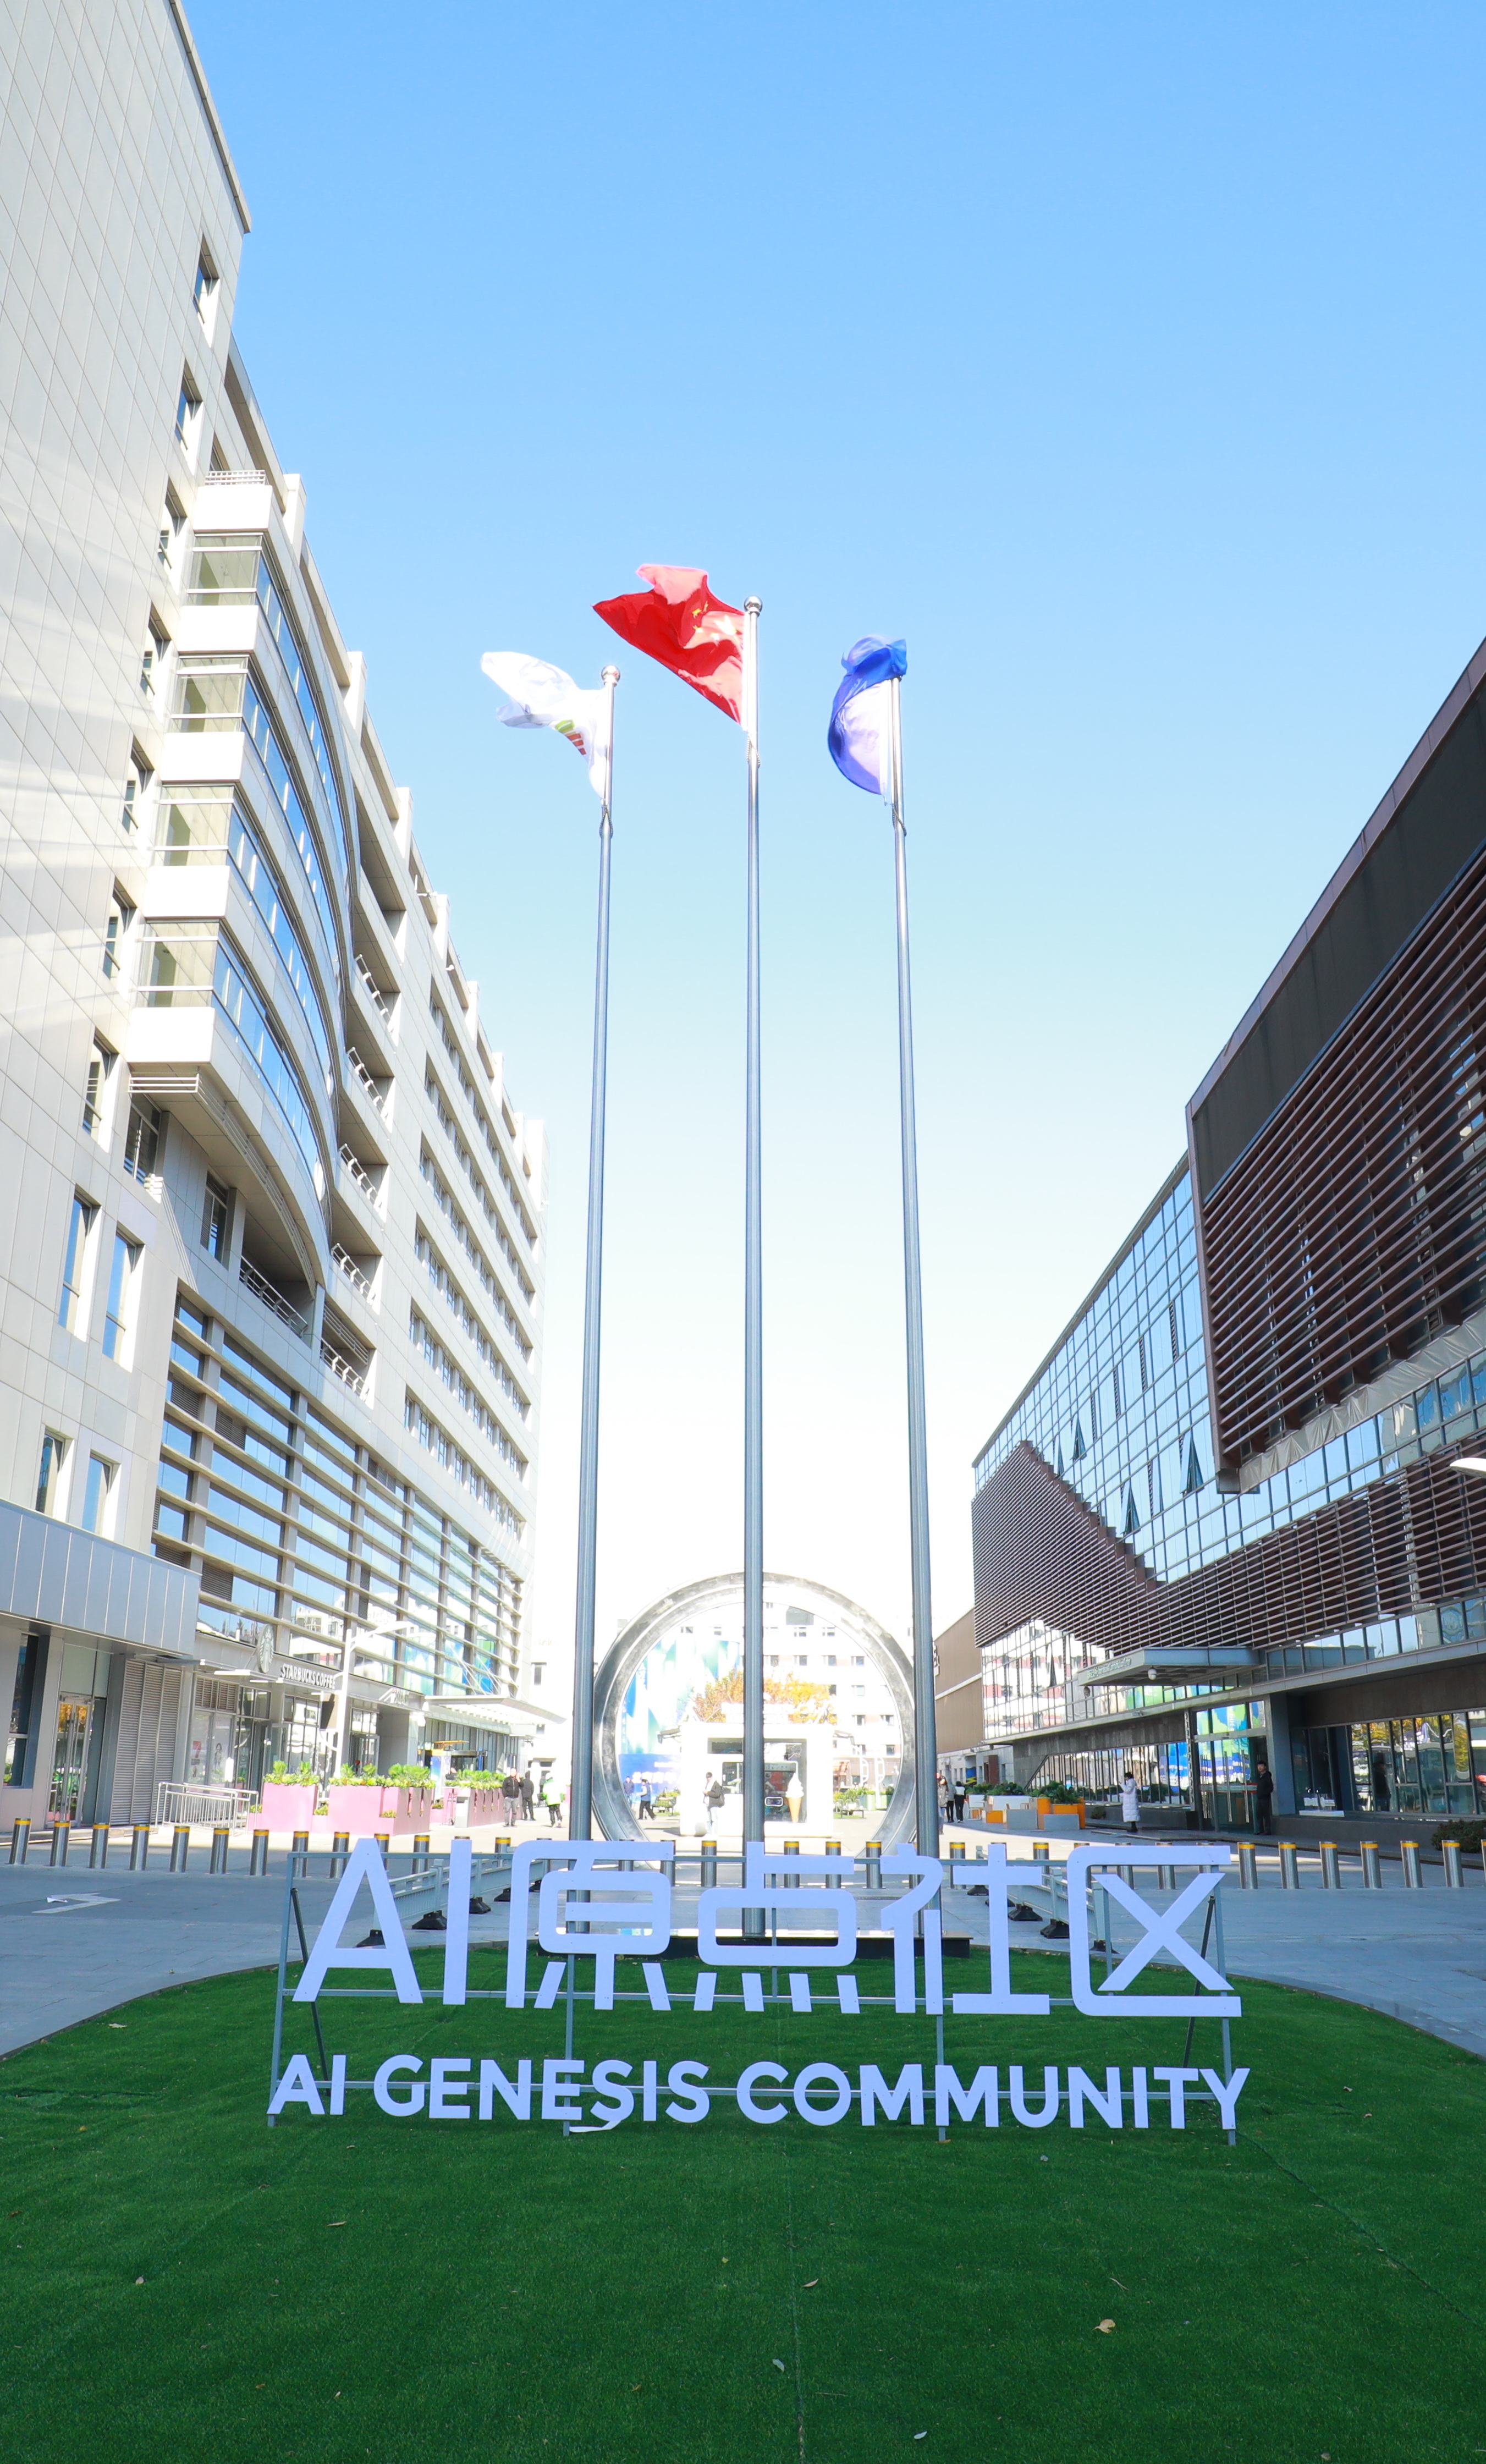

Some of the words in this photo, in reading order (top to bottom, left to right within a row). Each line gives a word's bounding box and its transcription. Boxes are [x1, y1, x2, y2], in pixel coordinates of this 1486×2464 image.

[281, 1663, 316, 1685] STARBUCKS
[316, 1672, 335, 1689] COFFEE
[267, 2055, 346, 2114] AI
[373, 2055, 709, 2124] GENESIS
[737, 2061, 1250, 2130] COMMUNITY
